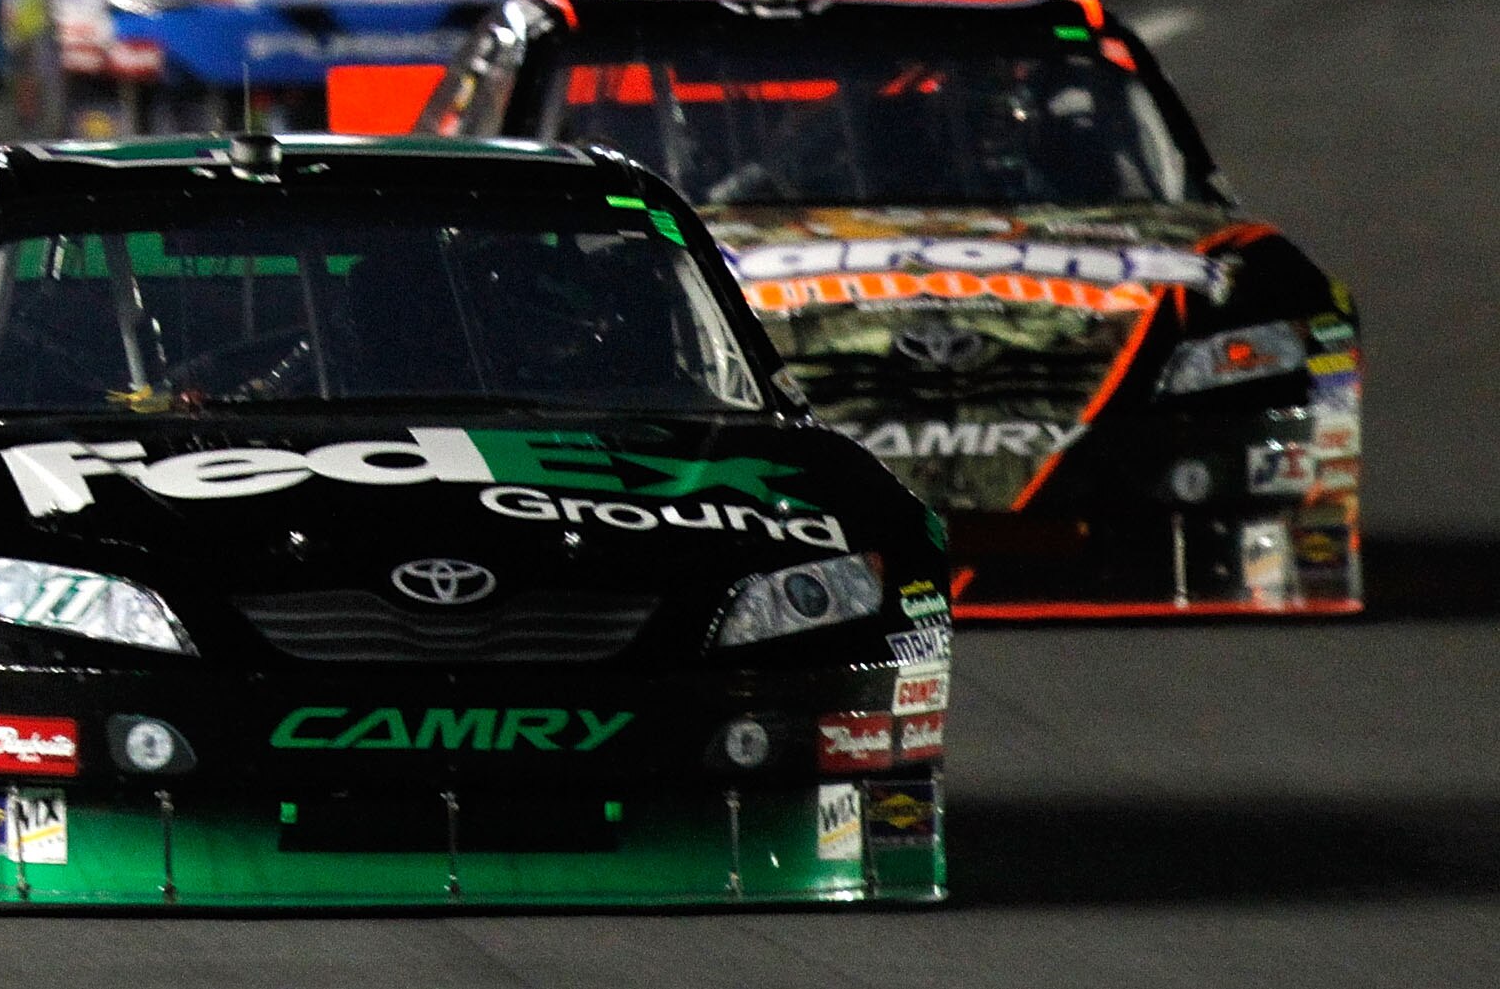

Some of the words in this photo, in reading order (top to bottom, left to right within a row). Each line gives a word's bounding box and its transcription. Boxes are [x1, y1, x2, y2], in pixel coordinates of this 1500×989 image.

[0, 425, 821, 519] FedEx
[479, 485, 849, 553] Ground
[19, 574, 111, 626] 11
[268, 706, 634, 752] CAMRY
